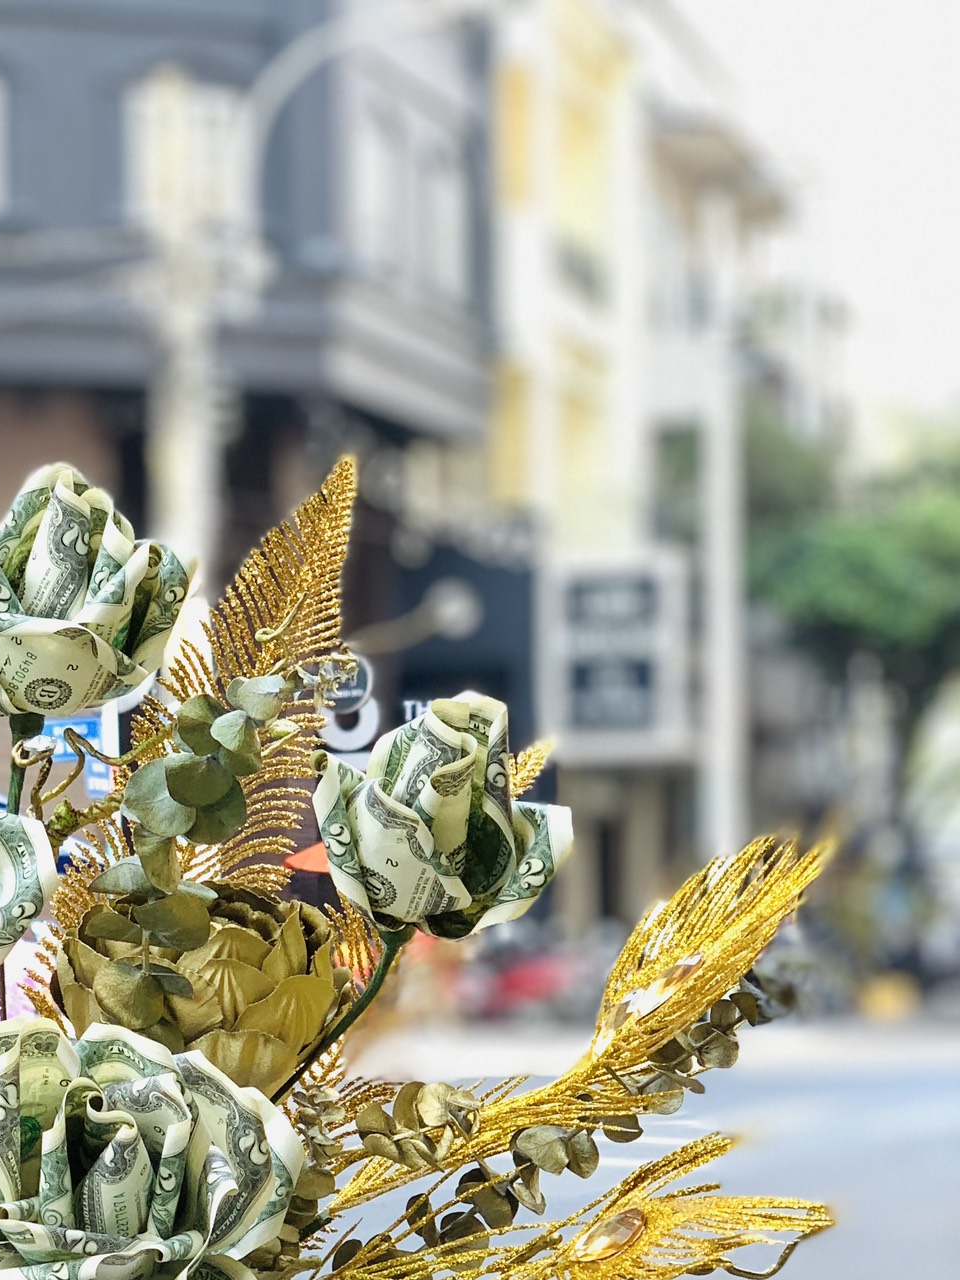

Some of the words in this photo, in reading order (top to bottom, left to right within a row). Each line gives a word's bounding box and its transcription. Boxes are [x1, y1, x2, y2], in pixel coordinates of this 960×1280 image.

[59, 583, 75, 606] TWO
[385, 857, 399, 868] 2
[519, 858, 546, 889] 2
